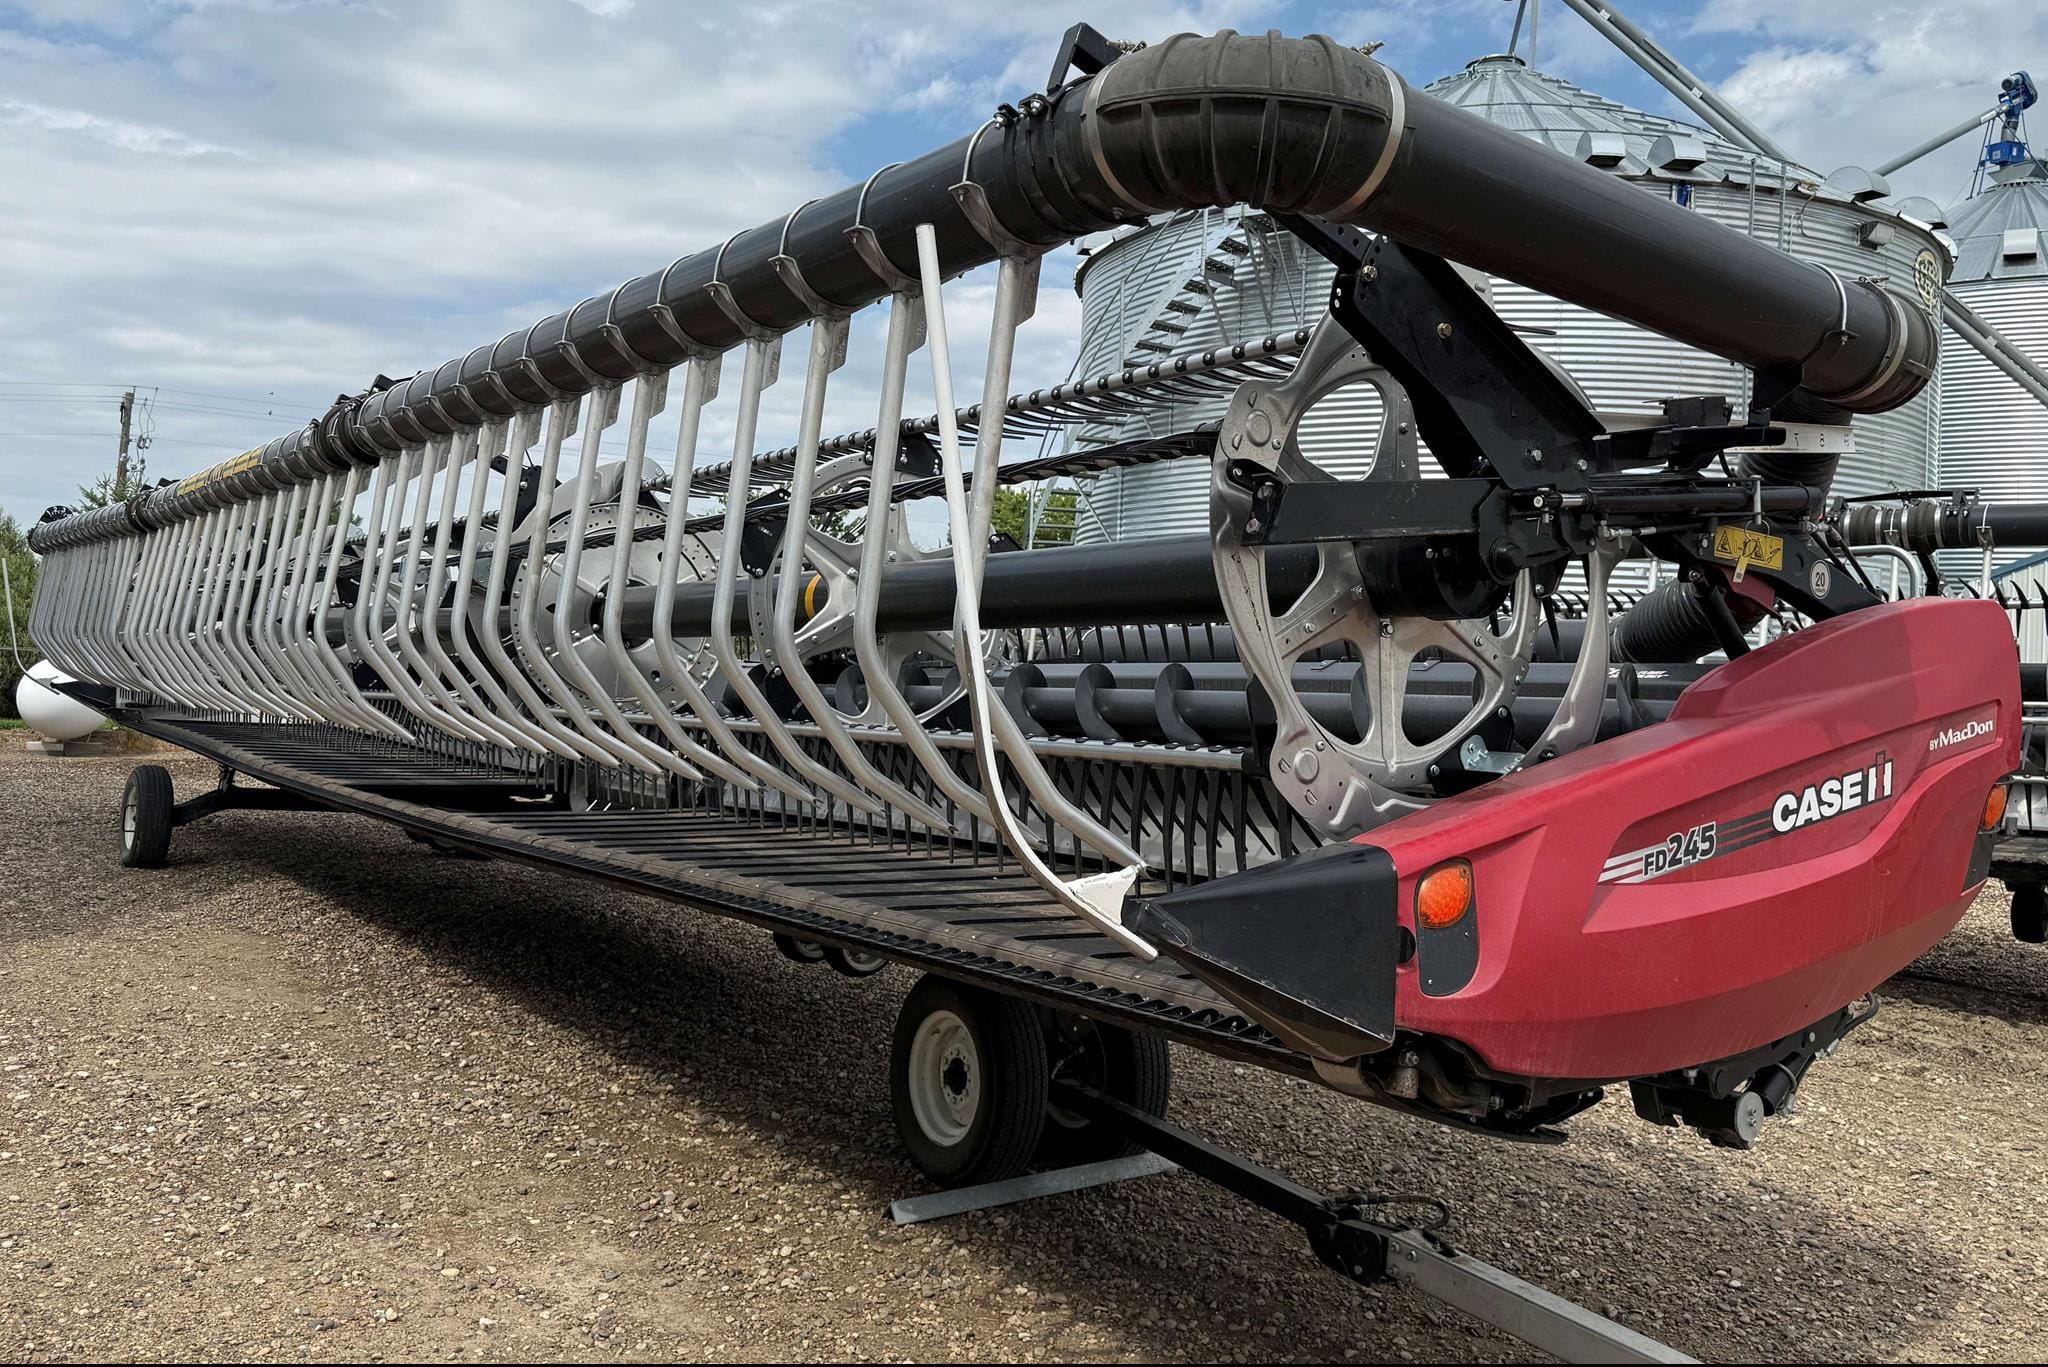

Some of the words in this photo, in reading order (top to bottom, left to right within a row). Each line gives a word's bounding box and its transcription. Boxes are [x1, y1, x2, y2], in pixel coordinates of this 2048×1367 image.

[1819, 433, 1825, 447] 8
[1815, 572, 1826, 587] 20
[1929, 737, 1939, 751] BY
[1939, 719, 1994, 748] MacDon
[1771, 769, 1863, 833] CASE
[1642, 821, 1717, 879] FD245
